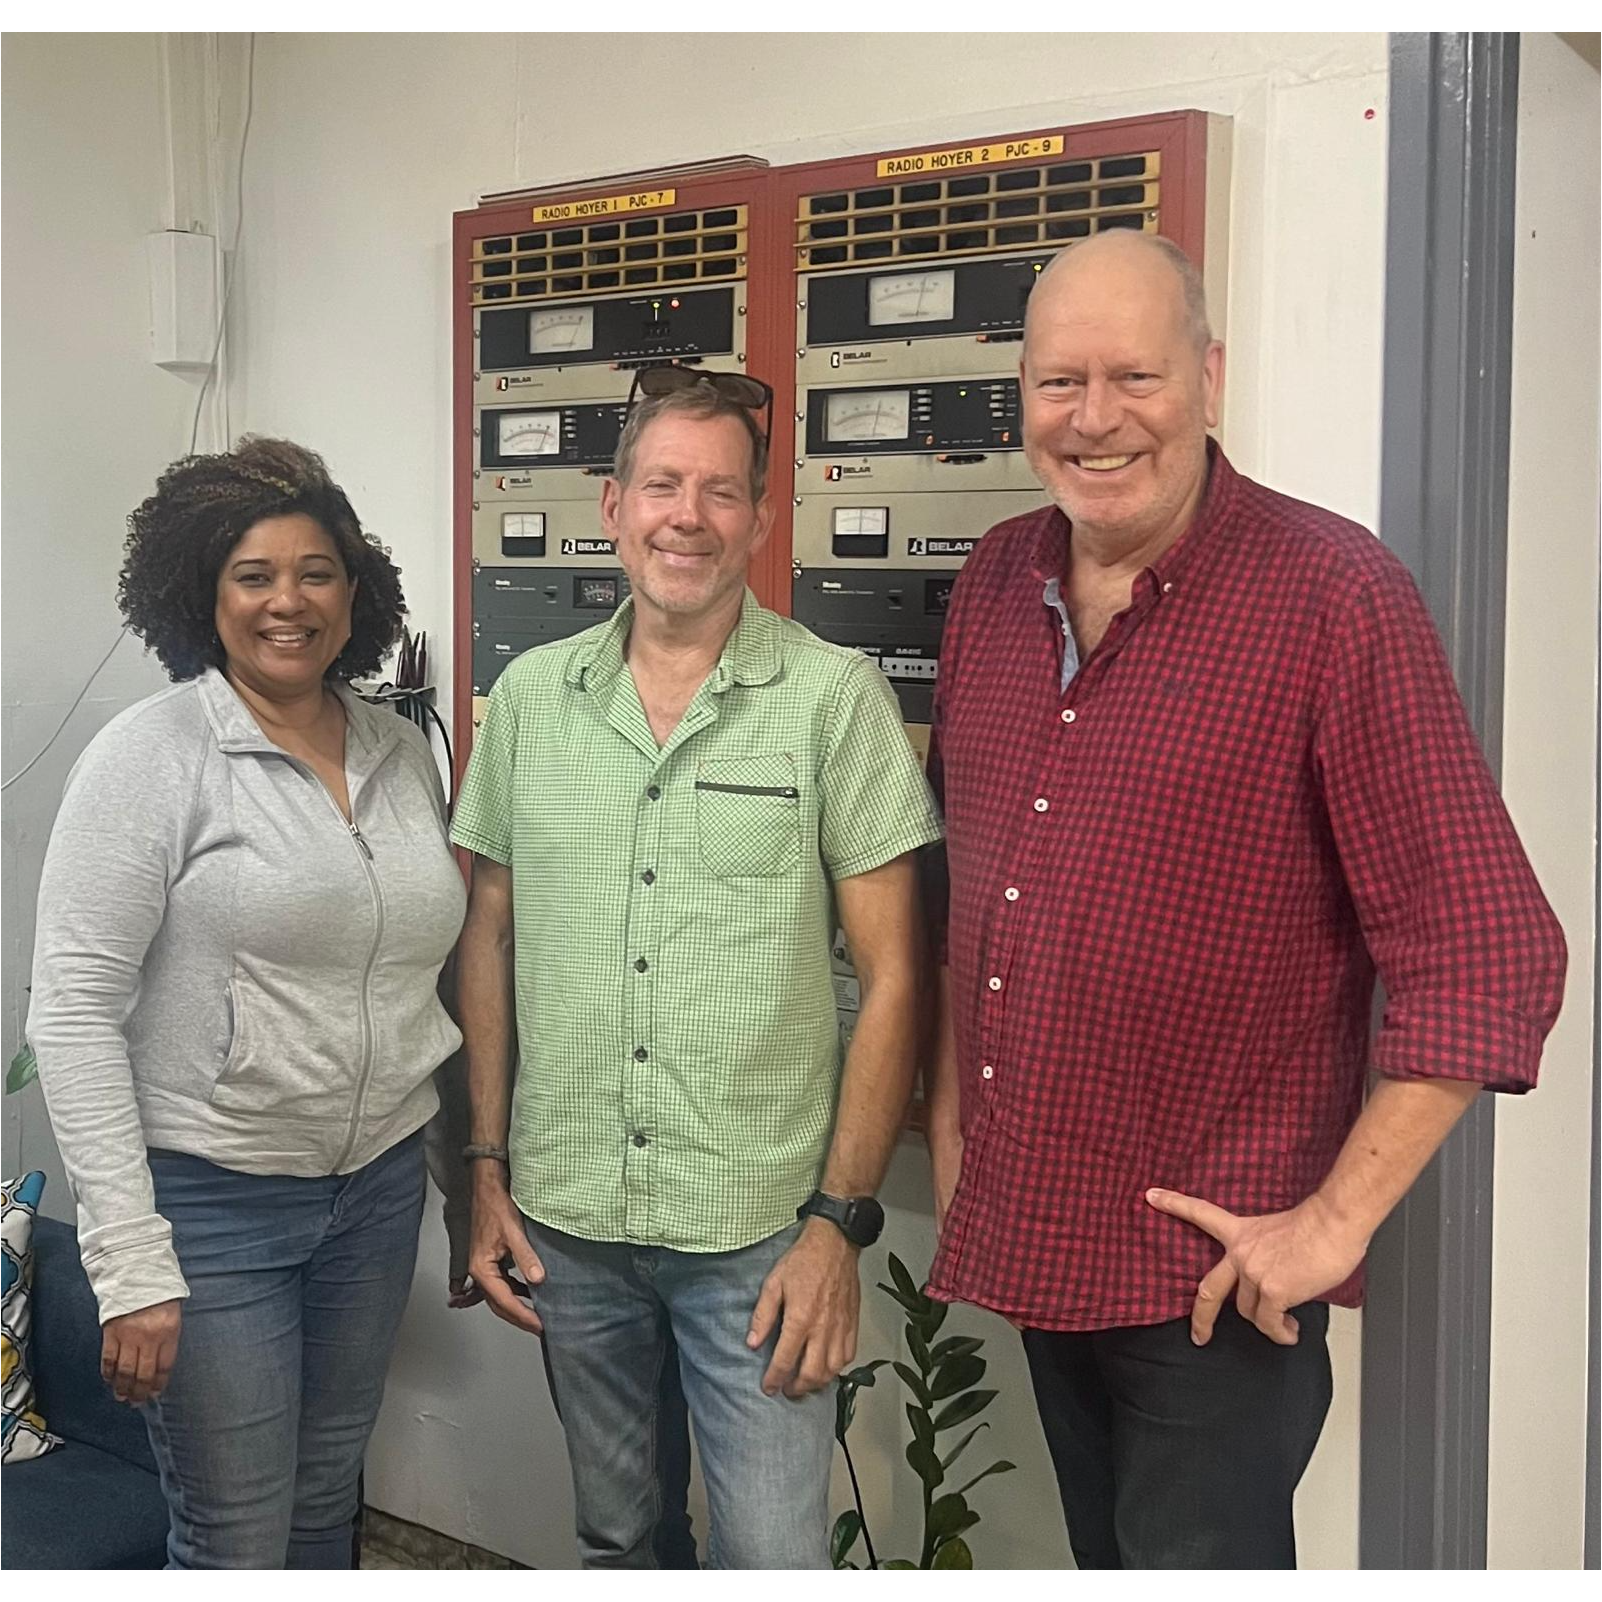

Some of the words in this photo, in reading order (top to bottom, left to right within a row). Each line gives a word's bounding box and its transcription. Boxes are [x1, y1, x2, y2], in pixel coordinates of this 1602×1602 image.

[887, 158, 924, 174] RADIO
[931, 151, 973, 168] HOYER
[981, 148, 990, 161] 2
[541, 206, 571, 219] RADIO
[575, 201, 608, 215] HOYER
[577, 542, 611, 551] BELAR
[929, 542, 973, 551] BELAR
